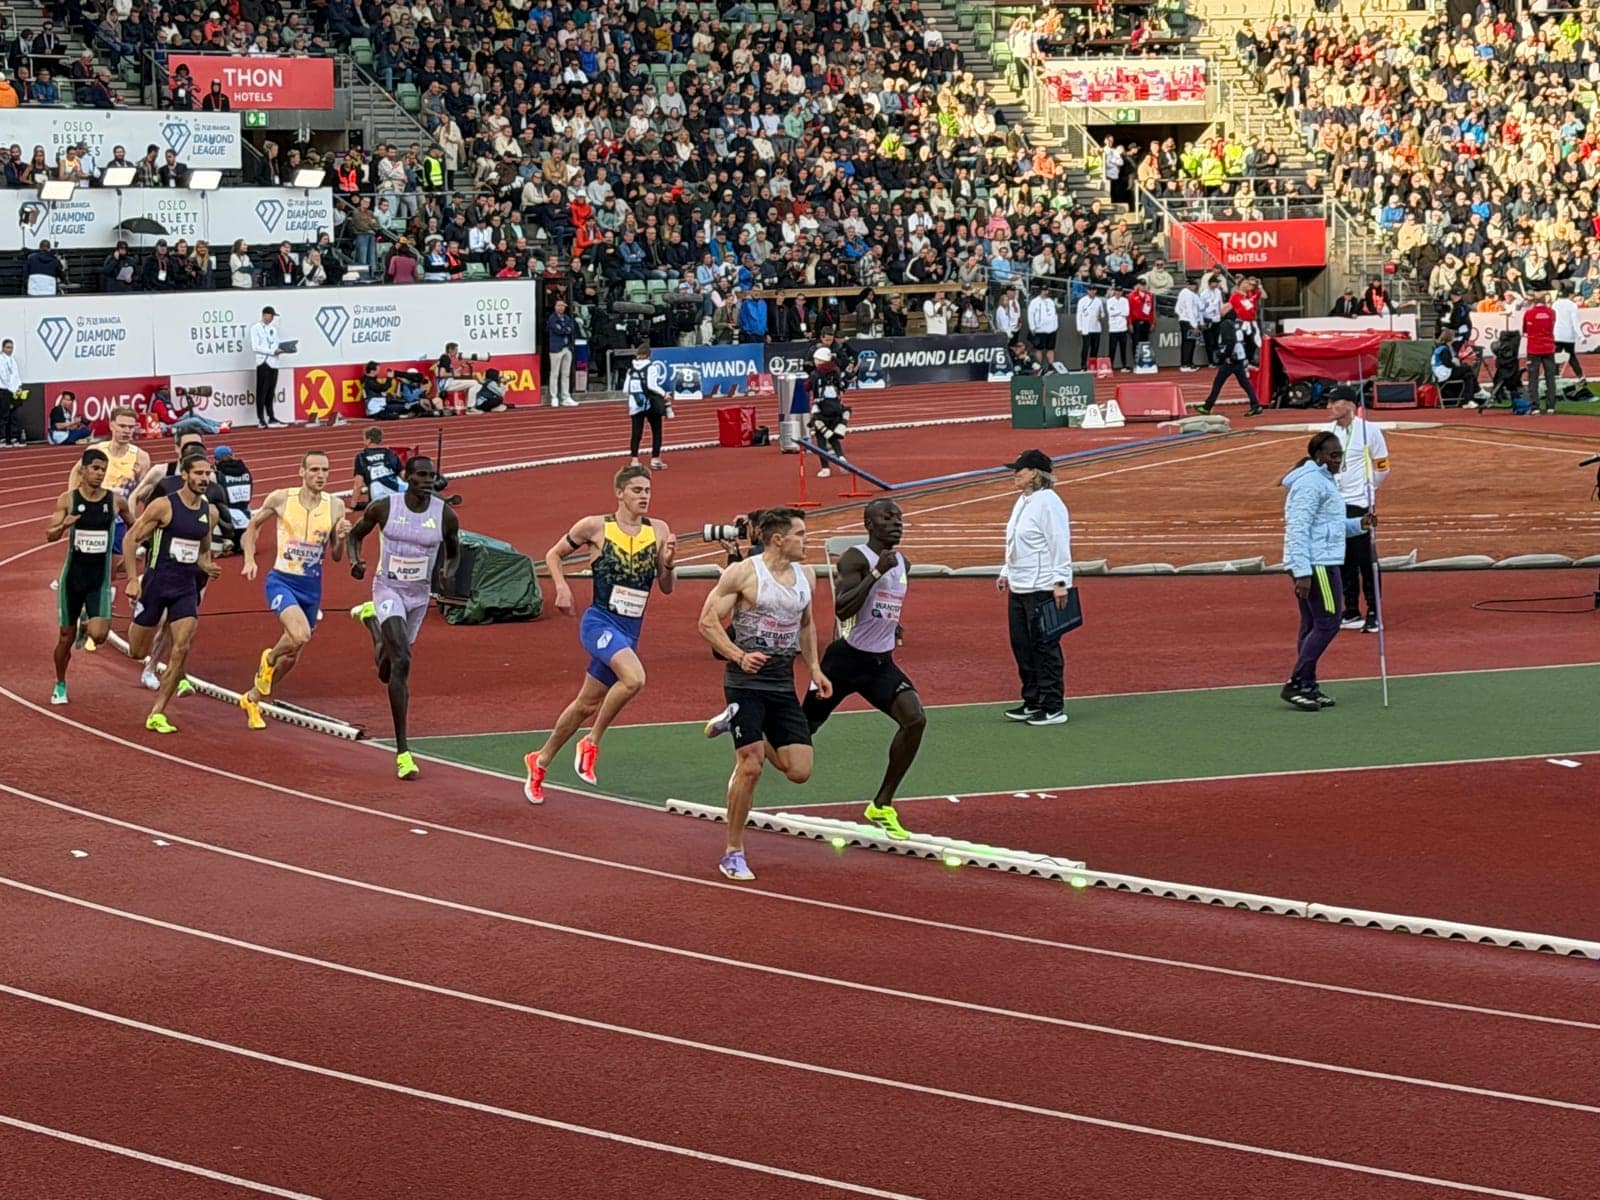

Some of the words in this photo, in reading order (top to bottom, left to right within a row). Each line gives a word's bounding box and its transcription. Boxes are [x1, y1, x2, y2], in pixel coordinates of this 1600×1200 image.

[223, 68, 283, 88] THON
[234, 92, 273, 102] HOTELS
[63, 121, 93, 132] OSLO
[53, 133, 104, 145] BISLETT
[193, 134, 234, 144] DIAMOND
[57, 145, 101, 157] GES
[192, 145, 226, 155] LEAGUE
[158, 200, 187, 211] OSLO
[51, 212, 95, 223] DIAMOND
[287, 209, 327, 219] DIAMOND
[50, 224, 86, 234] LEAGUE
[285, 221, 319, 231] LEAGUE
[1217, 230, 1278, 249] THON
[1227, 252, 1268, 263] HOTELS
[476, 298, 510, 311] OSLO
[202, 310, 234, 323] OSLO
[352, 315, 401, 330] DIAMOND
[464, 312, 523, 327] BISLETT
[76, 328, 126, 343] DIAMOND
[191, 325, 247, 341] BISLETT
[351, 330, 392, 344] LEAGUE
[469, 326, 518, 341] GAMES
[74, 344, 116, 358] LEAGUE
[196, 340, 243, 355] GAMES
[1142, 344, 1151, 358] 5
[865, 357, 876, 371] 7
[880, 350, 945, 368] DIAMOND
[995, 351, 1006, 364] 6
[701, 359, 757, 378] WANDA
[1059, 385, 1080, 395] OSLO
